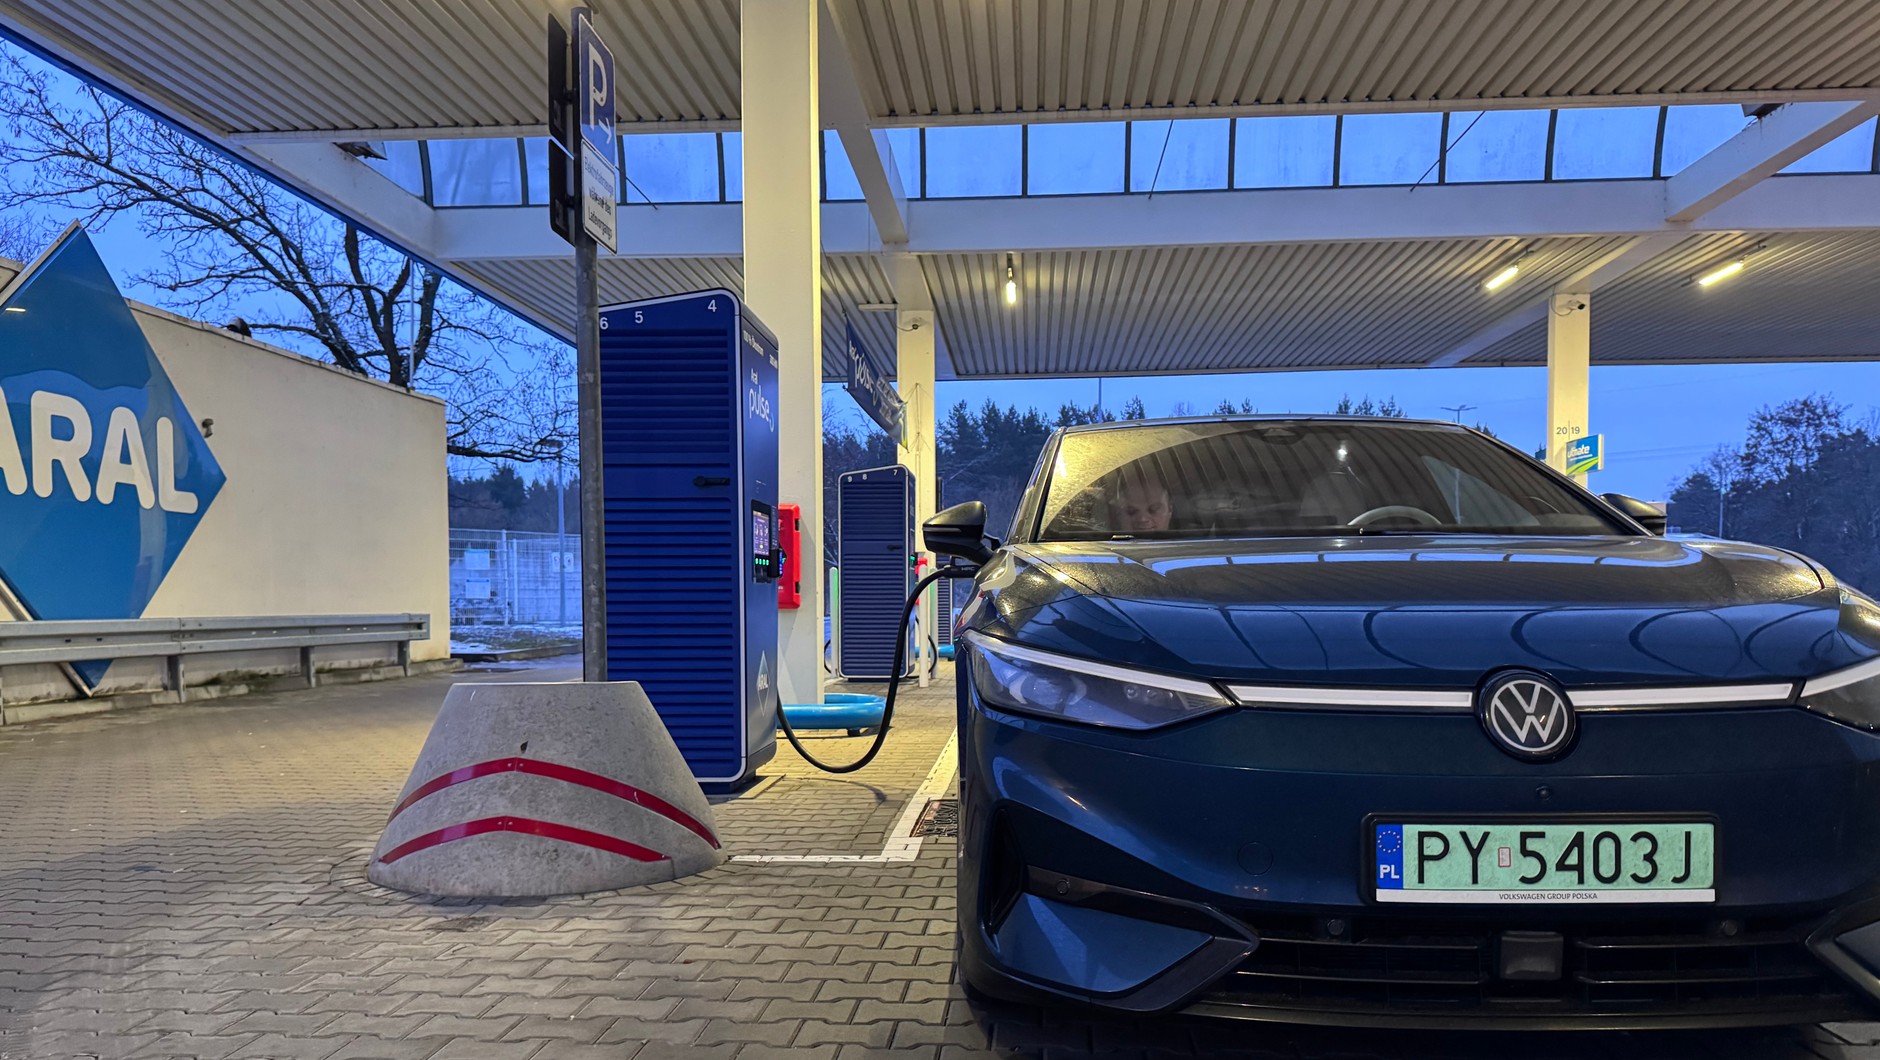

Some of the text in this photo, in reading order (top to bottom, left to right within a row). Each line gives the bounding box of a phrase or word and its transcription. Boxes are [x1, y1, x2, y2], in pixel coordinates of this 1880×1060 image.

[588, 42, 607, 130] P
[599, 299, 717, 330] 6 5 4
[749, 384, 770, 422] pulse
[1556, 426, 1581, 435] 20 19
[1379, 865, 1400, 880] PL
[1417, 831, 1693, 885] PY 5403J
[1499, 892, 1598, 901] VOLKSWAGEN GROUP POLSKA
